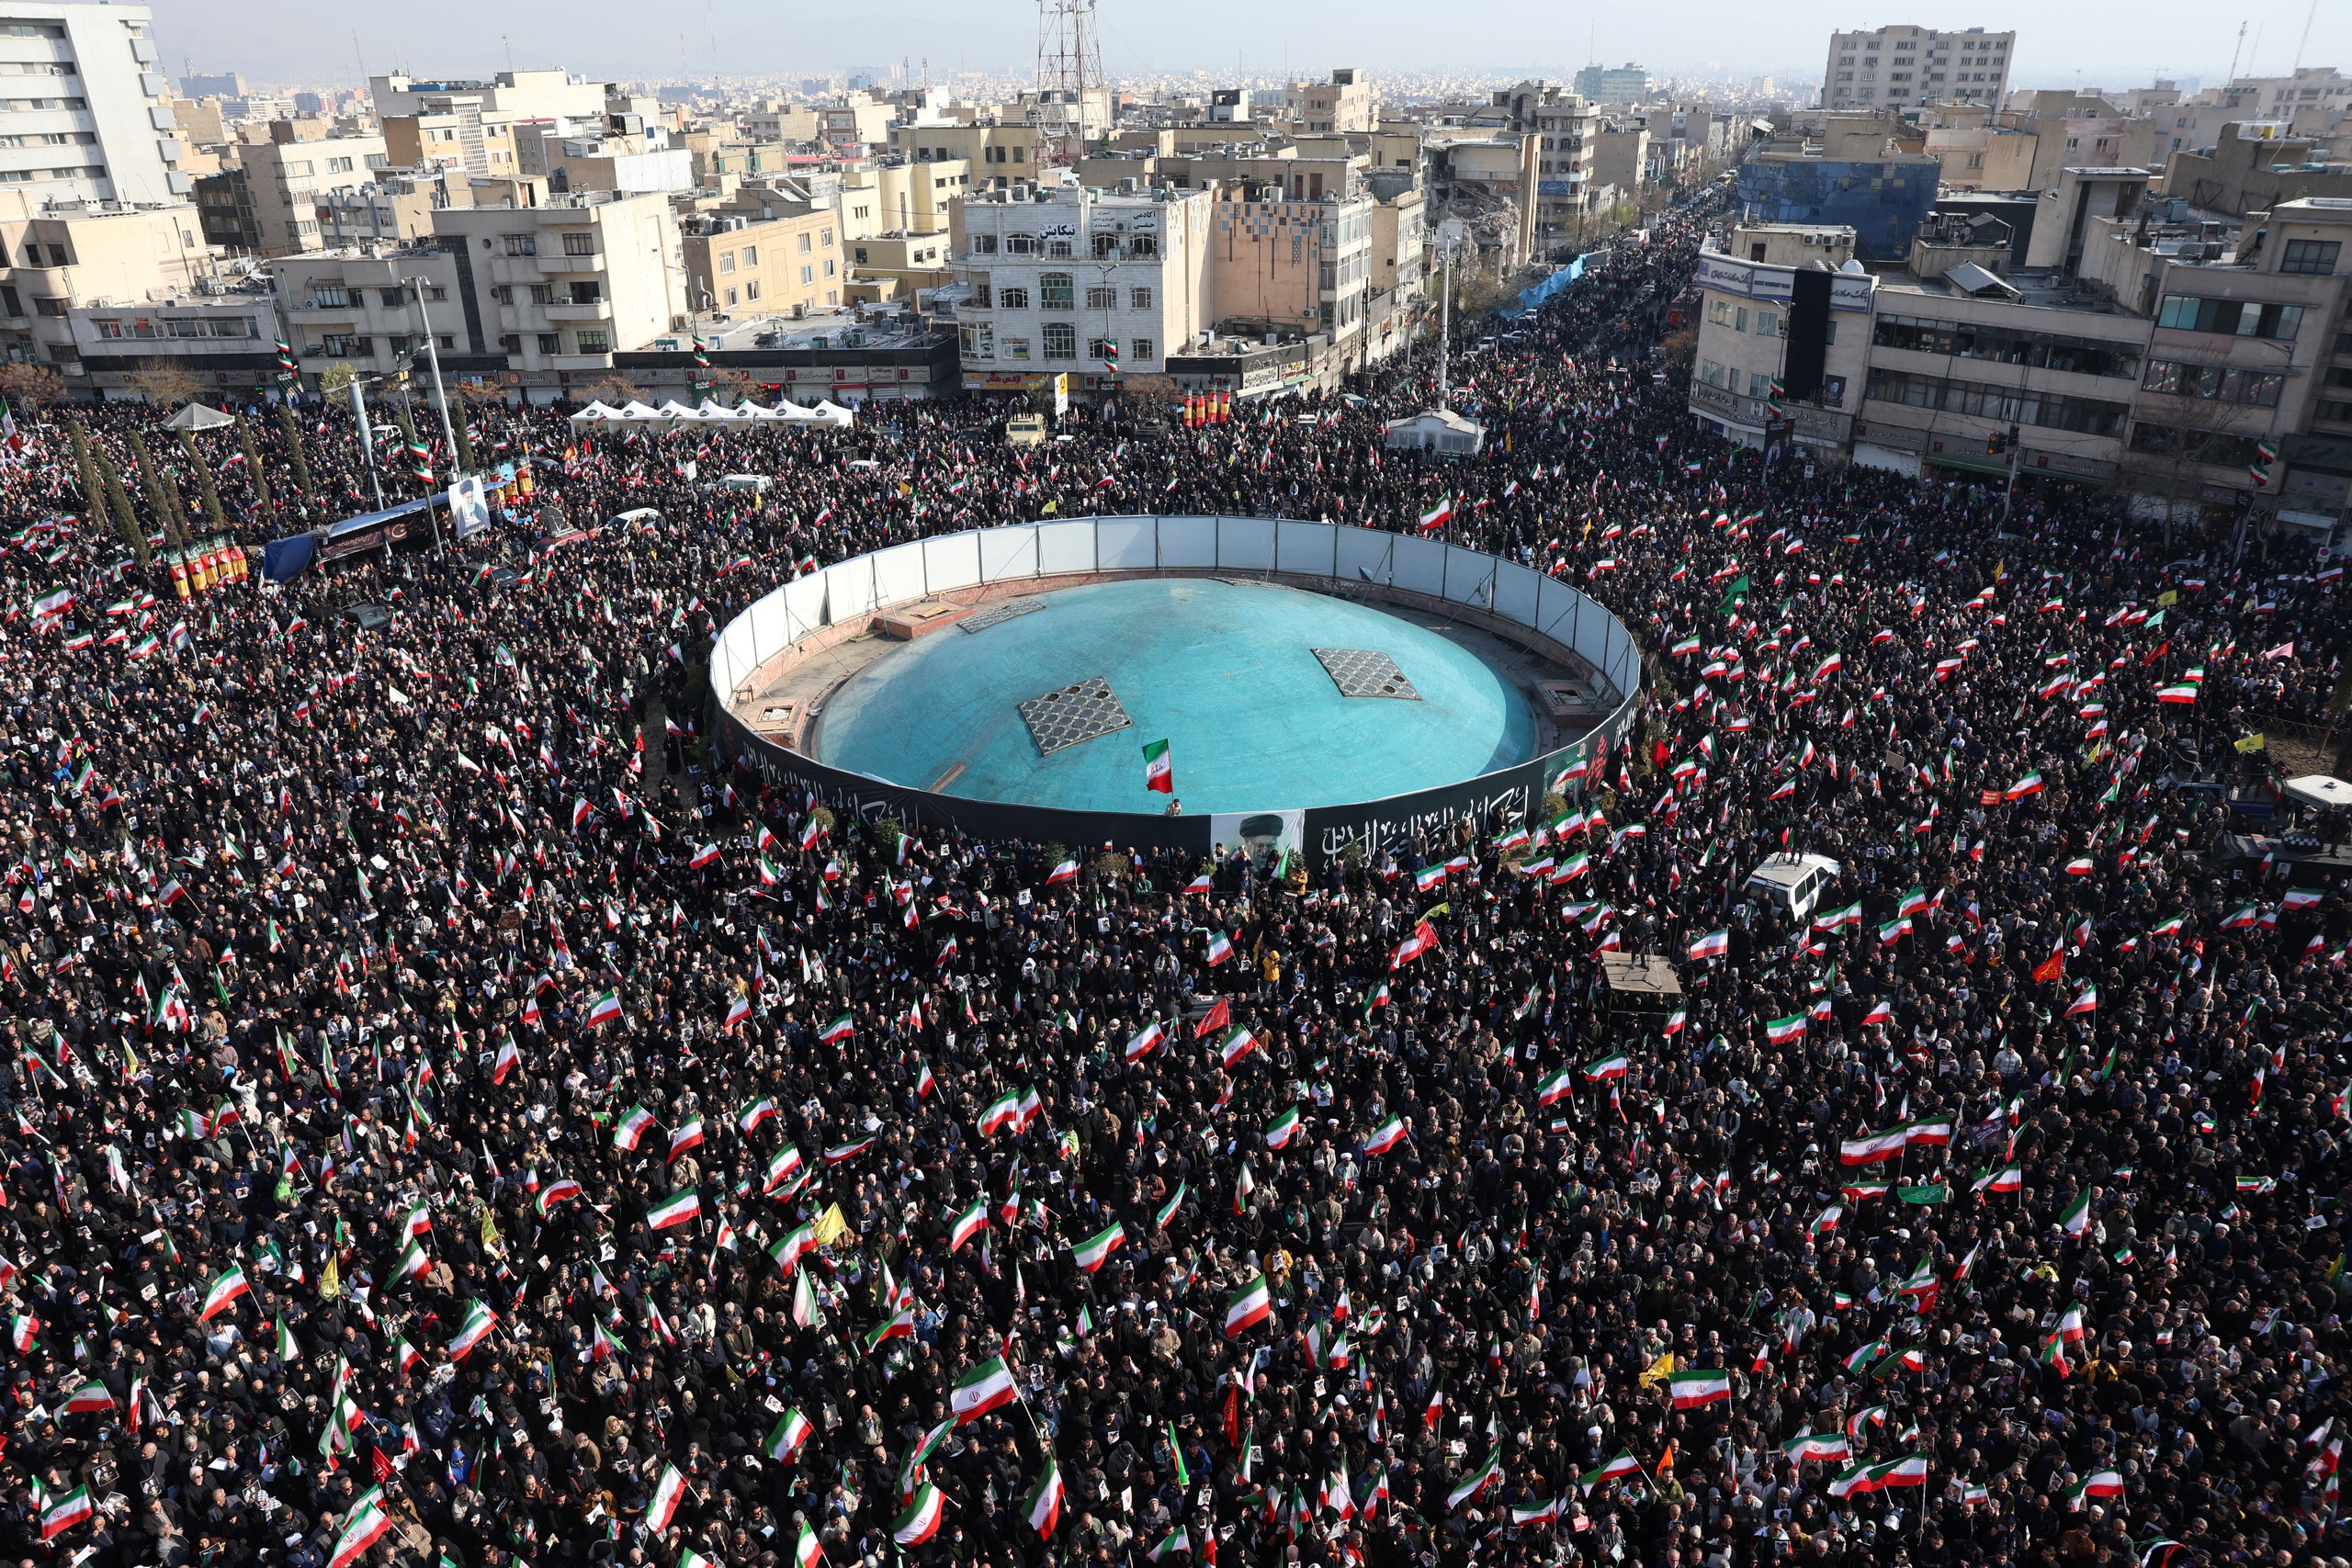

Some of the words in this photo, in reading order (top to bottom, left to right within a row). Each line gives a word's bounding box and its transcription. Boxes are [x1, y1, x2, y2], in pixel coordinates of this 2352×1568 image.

[1133, 210, 1157, 220] آکادمی
[1039, 224, 1076, 240] نیکایش
[1850, 287, 1871, 302] بانک
